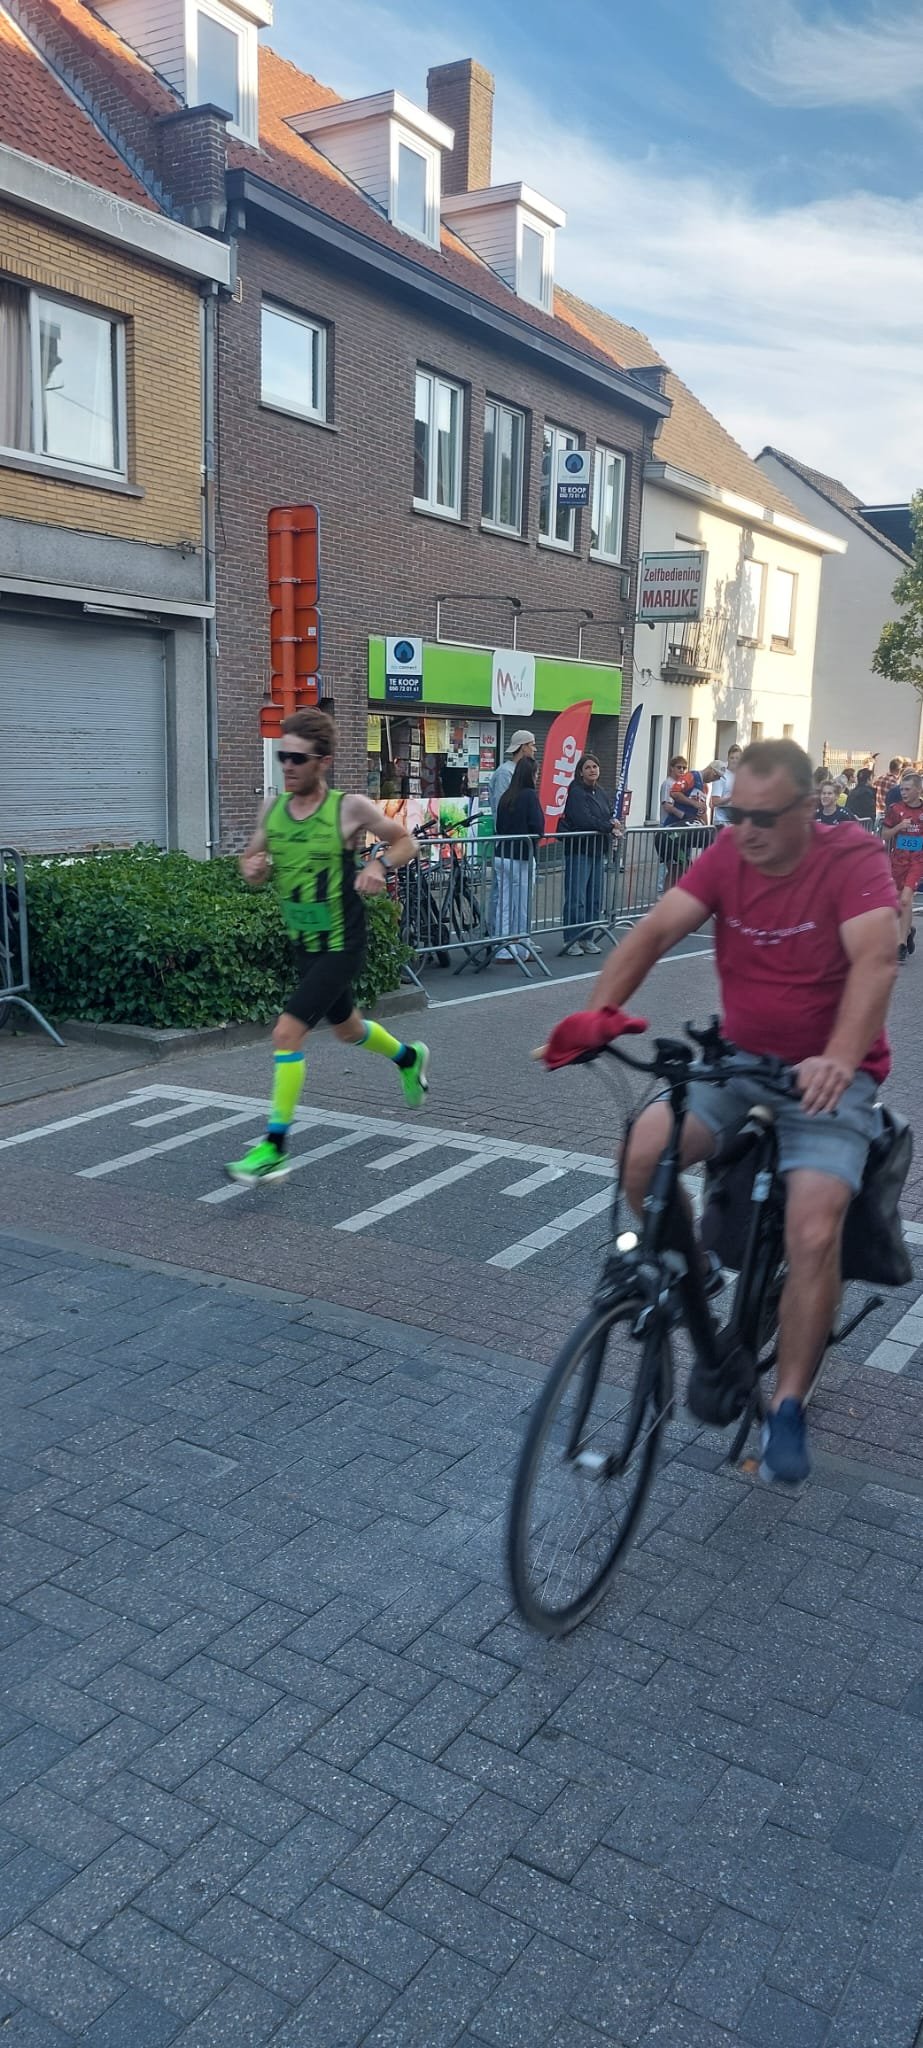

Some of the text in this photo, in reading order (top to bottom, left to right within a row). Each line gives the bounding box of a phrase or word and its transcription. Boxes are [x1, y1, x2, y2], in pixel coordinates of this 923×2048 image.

[644, 567, 701, 582] Zelfbediening
[642, 588, 699, 608] MARIJKE
[389, 678, 419, 687] TE KOOP
[546, 735, 582, 816] lotto
[902, 838, 918, 848] 263
